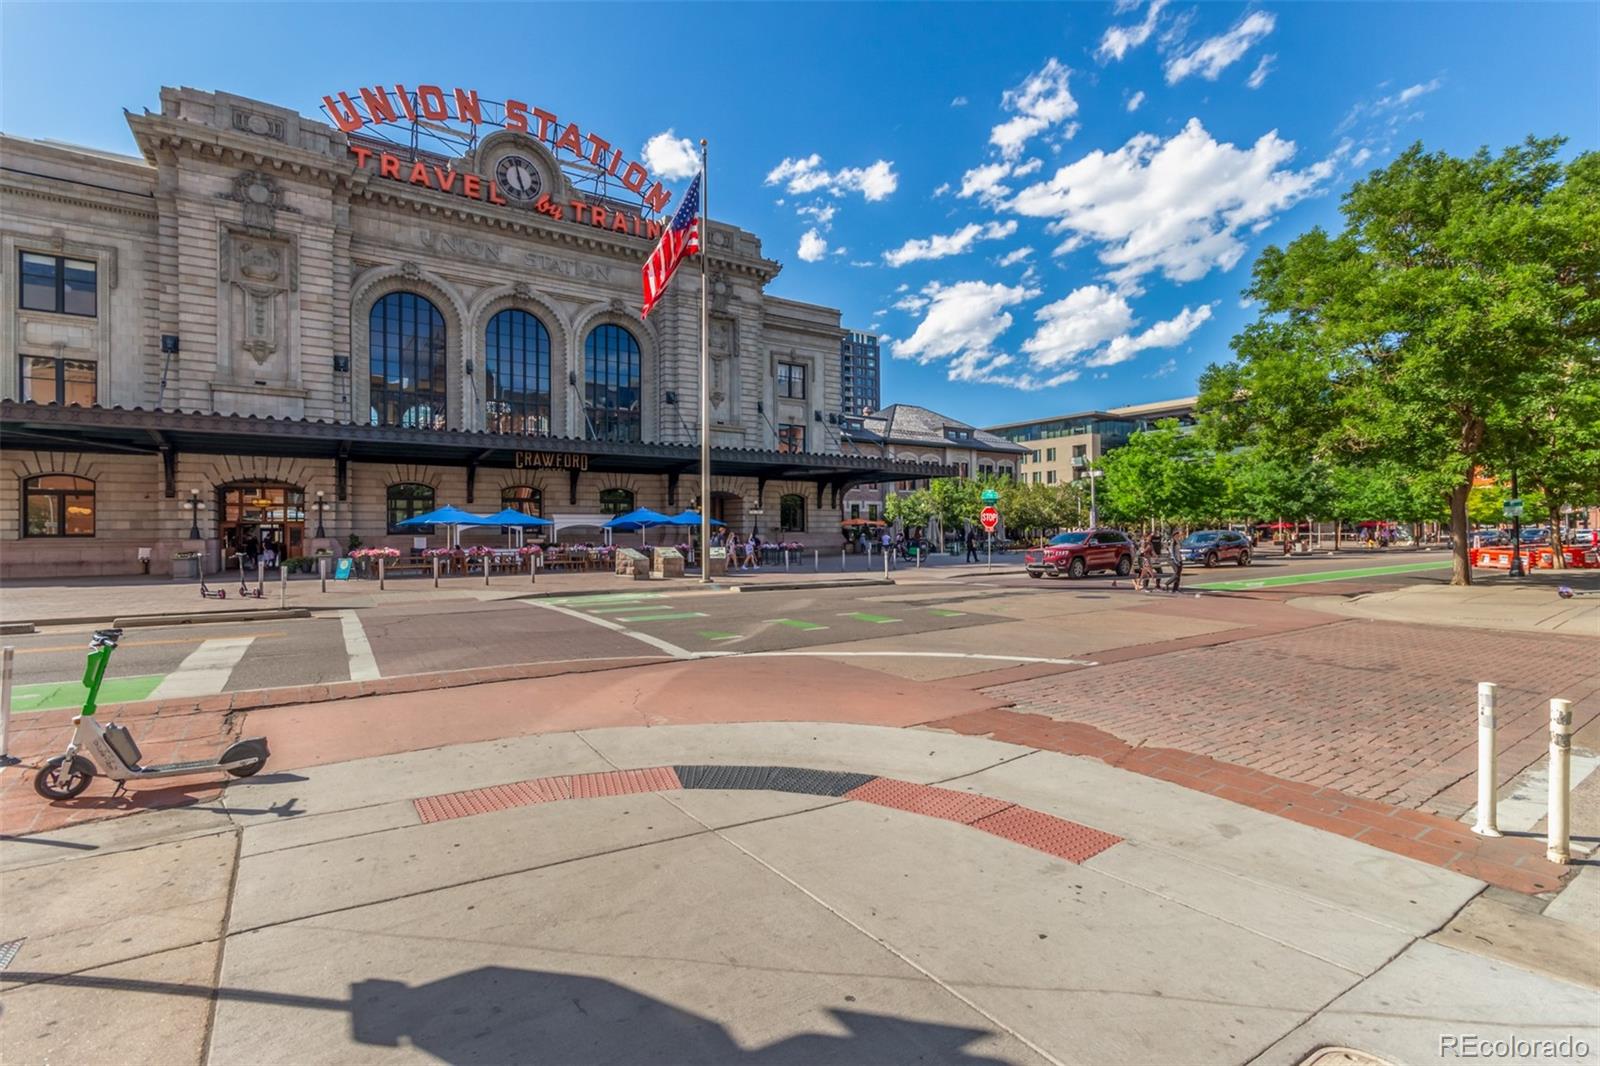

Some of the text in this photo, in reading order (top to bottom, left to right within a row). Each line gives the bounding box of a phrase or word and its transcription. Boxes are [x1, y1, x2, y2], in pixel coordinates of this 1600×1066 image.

[322, 84, 482, 132] UNION
[505, 99, 672, 213] STATION
[350, 145, 506, 206] TRAVEL
[535, 192, 564, 221] by
[571, 200, 661, 240] TRAIN
[417, 228, 611, 281] UNION STATION
[515, 451, 588, 471] CRAWFORD
[982, 513, 998, 522] STOP
